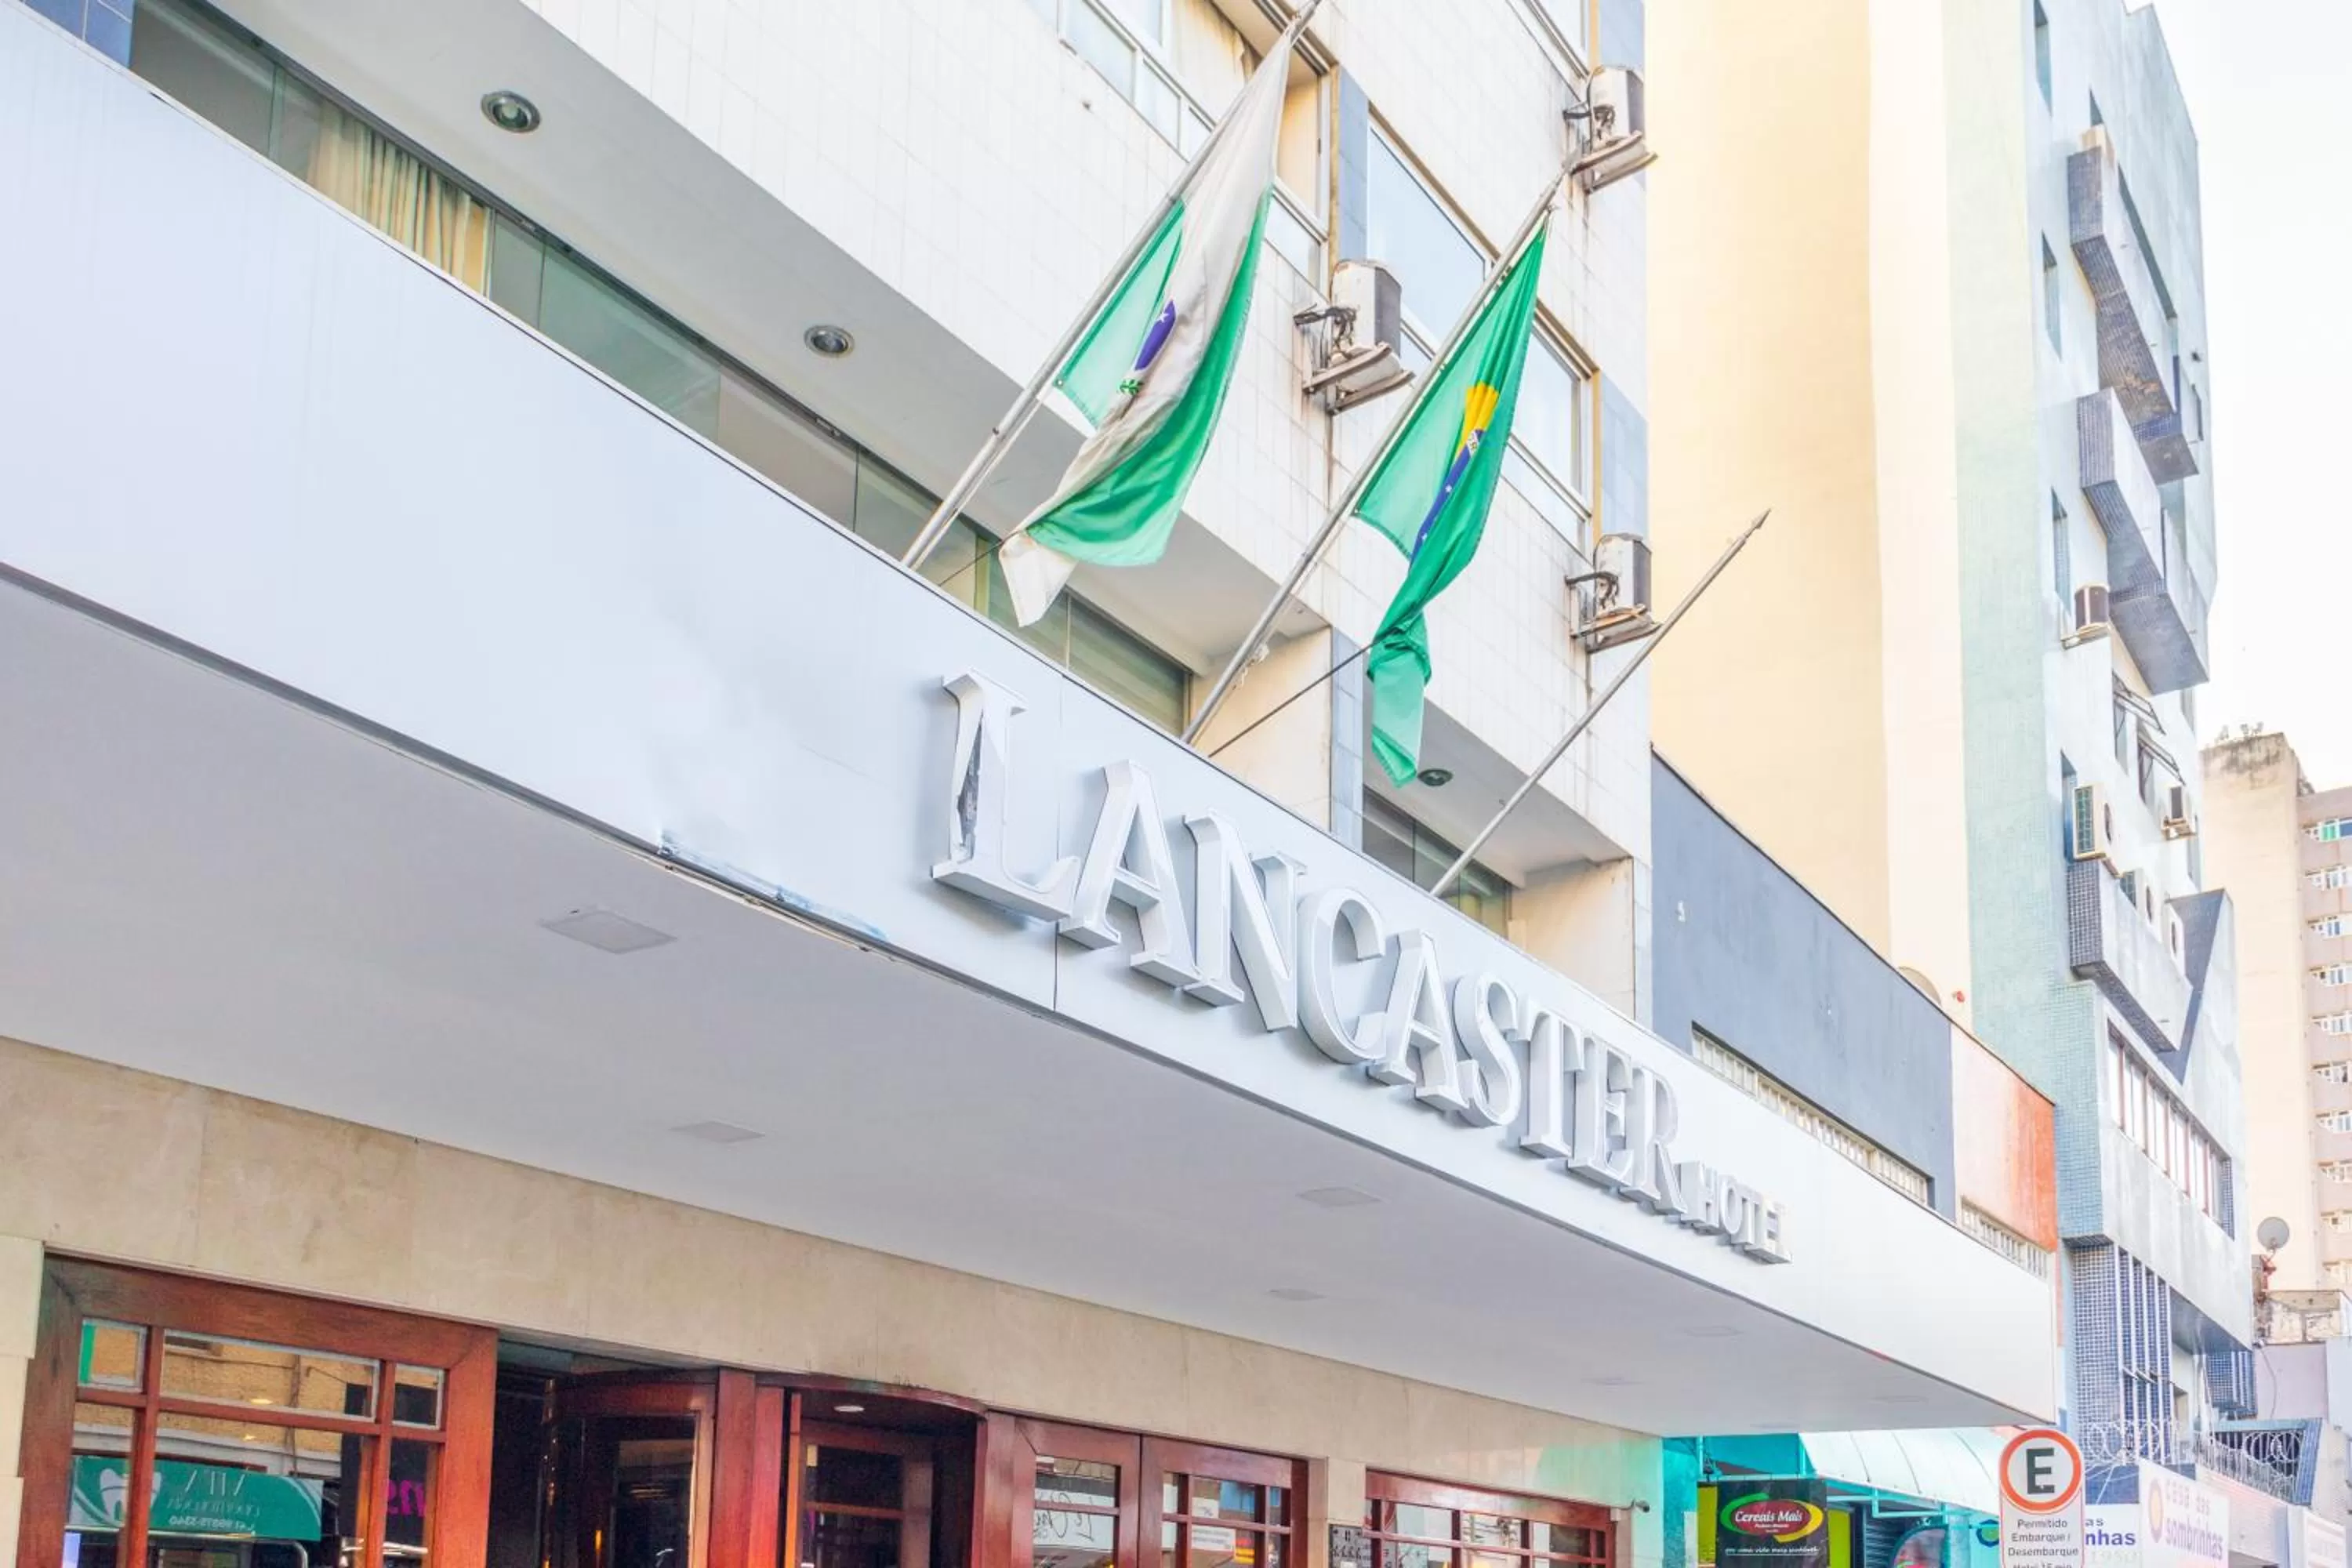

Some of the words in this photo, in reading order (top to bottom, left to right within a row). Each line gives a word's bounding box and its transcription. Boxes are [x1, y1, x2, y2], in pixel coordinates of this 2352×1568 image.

[931, 668, 1687, 1217] LANCASTER
[2027, 1448, 2054, 1494] E
[1735, 1511, 1774, 1523] Cereais
[1777, 1510, 1802, 1523] Mais
[2017, 1518, 2068, 1529] Permitido
[2011, 1533, 2067, 1543] Embarque
[2008, 1547, 2079, 1557] Desembarque
